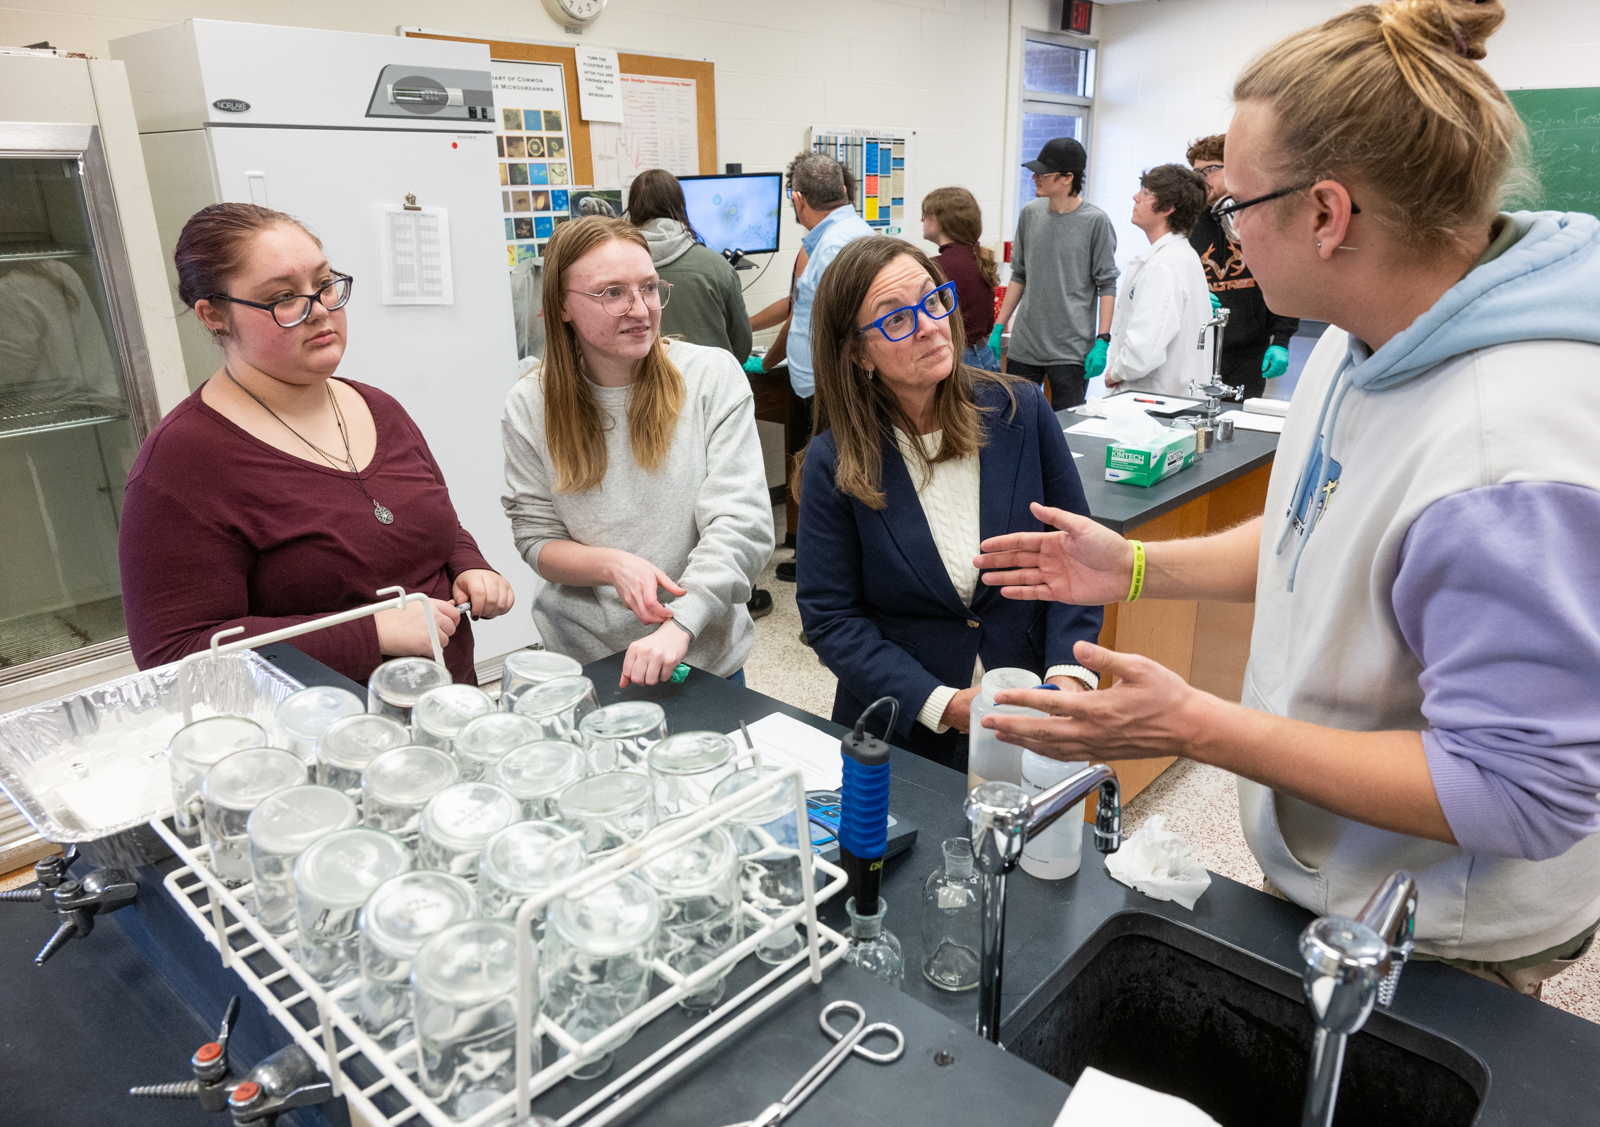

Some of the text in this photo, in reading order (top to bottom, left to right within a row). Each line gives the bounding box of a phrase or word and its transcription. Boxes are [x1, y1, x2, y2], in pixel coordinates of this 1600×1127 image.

[578, 5, 582, 13] 6
[587, 3, 591, 11] 5
[1072, 1, 1090, 30] EXIT
[501, 84, 554, 92] MICROORGANISMS
[217, 101, 247, 110] NORLAKE
[851, 129, 881, 137] CHEMICALS
[1111, 451, 1144, 461] KIMTECH
